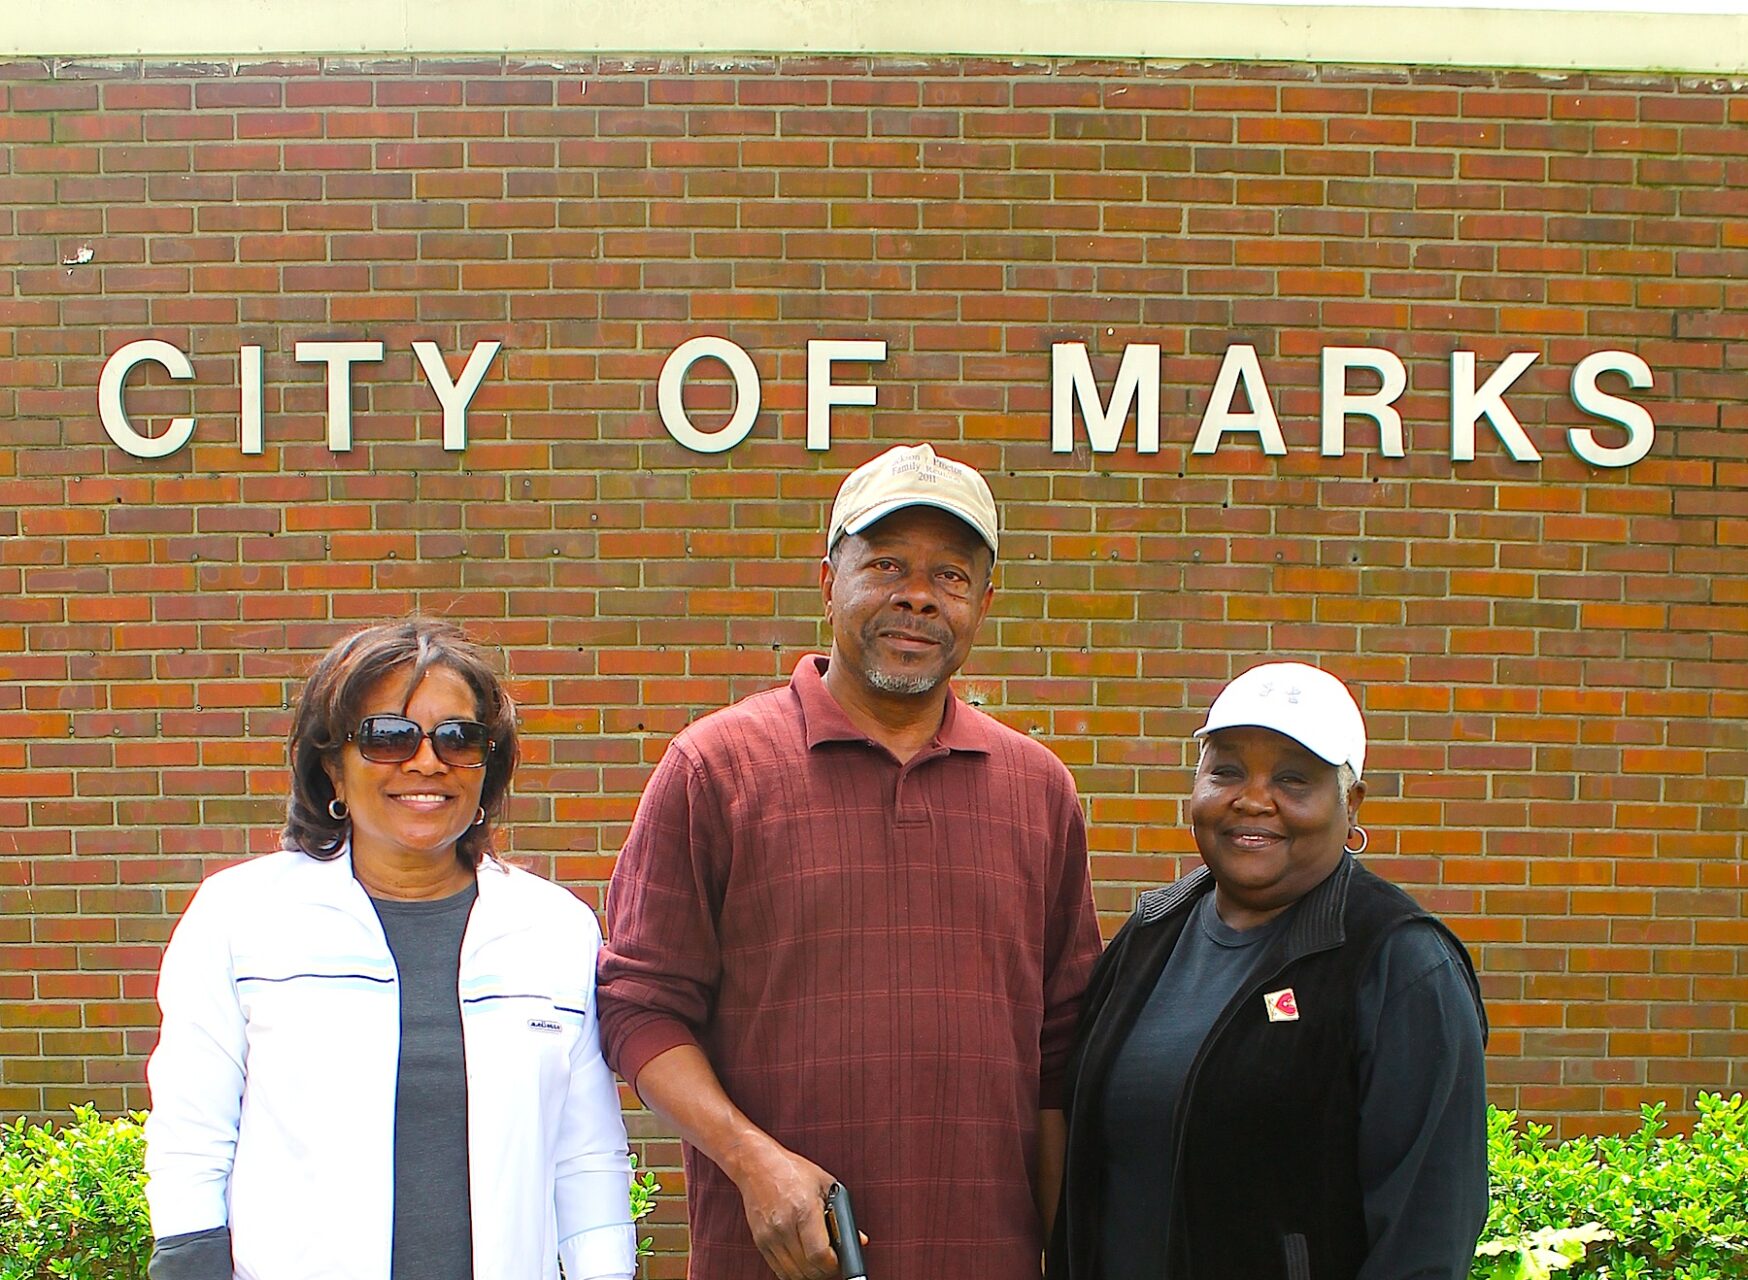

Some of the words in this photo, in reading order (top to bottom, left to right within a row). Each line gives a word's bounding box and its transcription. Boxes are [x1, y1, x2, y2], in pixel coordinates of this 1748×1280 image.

[97, 338, 502, 458] CITY
[657, 335, 889, 453] OF
[1051, 342, 1657, 469] MARKS
[892, 462, 920, 476] Family
[918, 472, 936, 483] 2011
